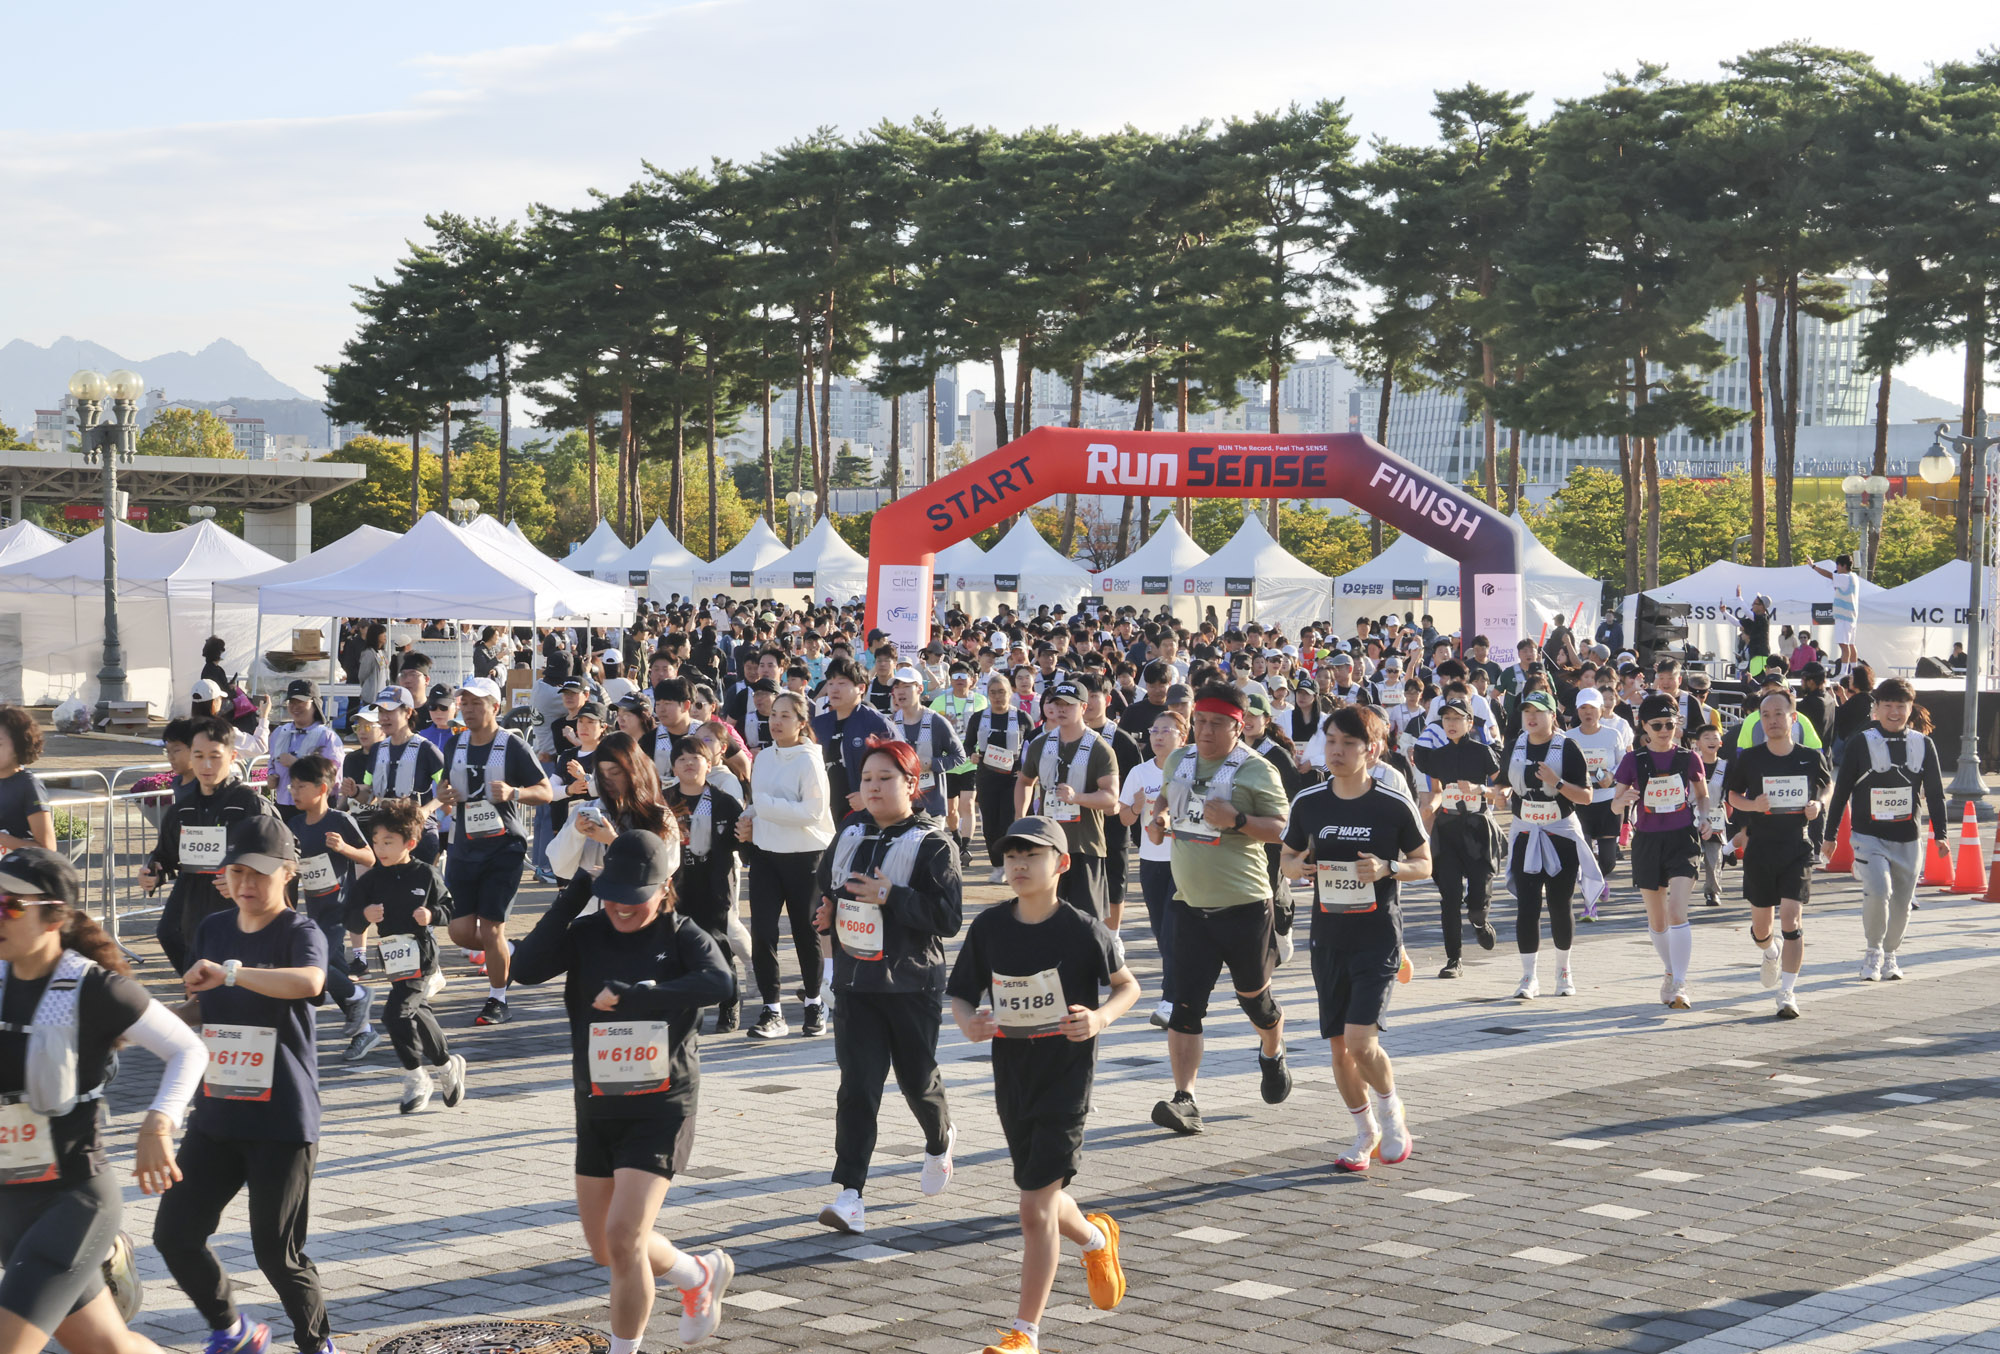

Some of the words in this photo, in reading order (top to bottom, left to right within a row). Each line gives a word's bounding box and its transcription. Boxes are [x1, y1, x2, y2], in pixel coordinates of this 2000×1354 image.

[926, 456, 1034, 532] START
[1369, 462, 1481, 541] FINISH
[1114, 578, 1130, 587] Short
[1196, 580, 1213, 588] Short
[1353, 584, 1384, 596] 오늘덤핑
[1911, 607, 1944, 624] MC
[1489, 646, 1513, 655] Choco
[1487, 654, 1515, 664] Health
[1453, 794, 1477, 802] 6104
[1655, 787, 1681, 798] 6175
[1777, 788, 1803, 797] 5160
[1884, 799, 1908, 807] 5026
[473, 810, 496, 823] 5059
[1532, 811, 1557, 821] 6414
[1338, 826, 1372, 837] HAPPS
[188, 842, 220, 853] 5082
[303, 868, 328, 880] 5057
[1325, 880, 1333, 888] M
[839, 919, 846, 928] W
[847, 920, 876, 935] 6080
[383, 948, 411, 961] 5081
[1010, 992, 1055, 1011] 5188
[217, 1050, 264, 1067] 6179
[597, 1049, 609, 1061] W
[611, 1046, 658, 1062] 6180
